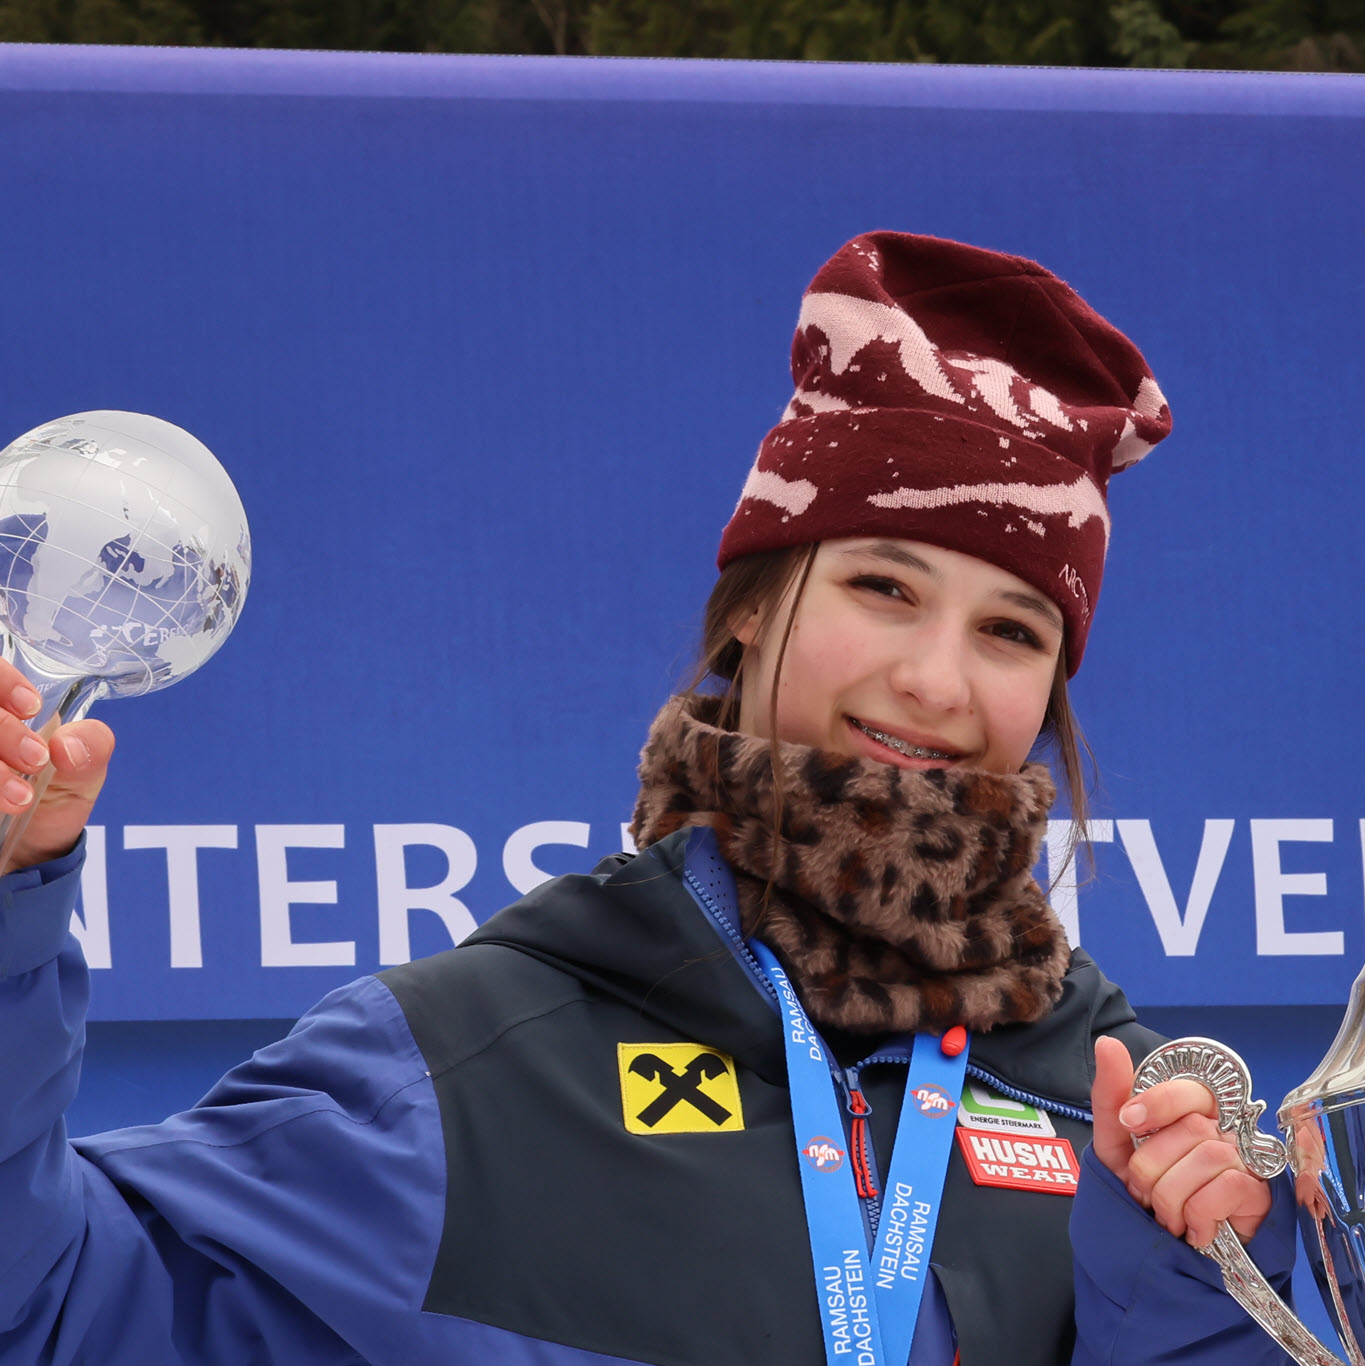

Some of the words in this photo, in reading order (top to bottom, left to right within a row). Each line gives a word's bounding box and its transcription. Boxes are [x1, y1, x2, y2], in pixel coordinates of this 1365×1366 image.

[771, 967, 806, 1043] RAMSAU
[969, 1135, 1071, 1170] HUSKI
[970, 1116, 1000, 1125] ENERGIE
[1001, 1119, 1043, 1129] STEIERMARK
[980, 1163, 1078, 1185] WEAR
[876, 1182, 913, 1289] DACHSTEIN
[901, 1201, 931, 1280] RAMSAU
[823, 1265, 852, 1354] RAMSAU
[843, 1249, 876, 1366] DACHSTEIN
